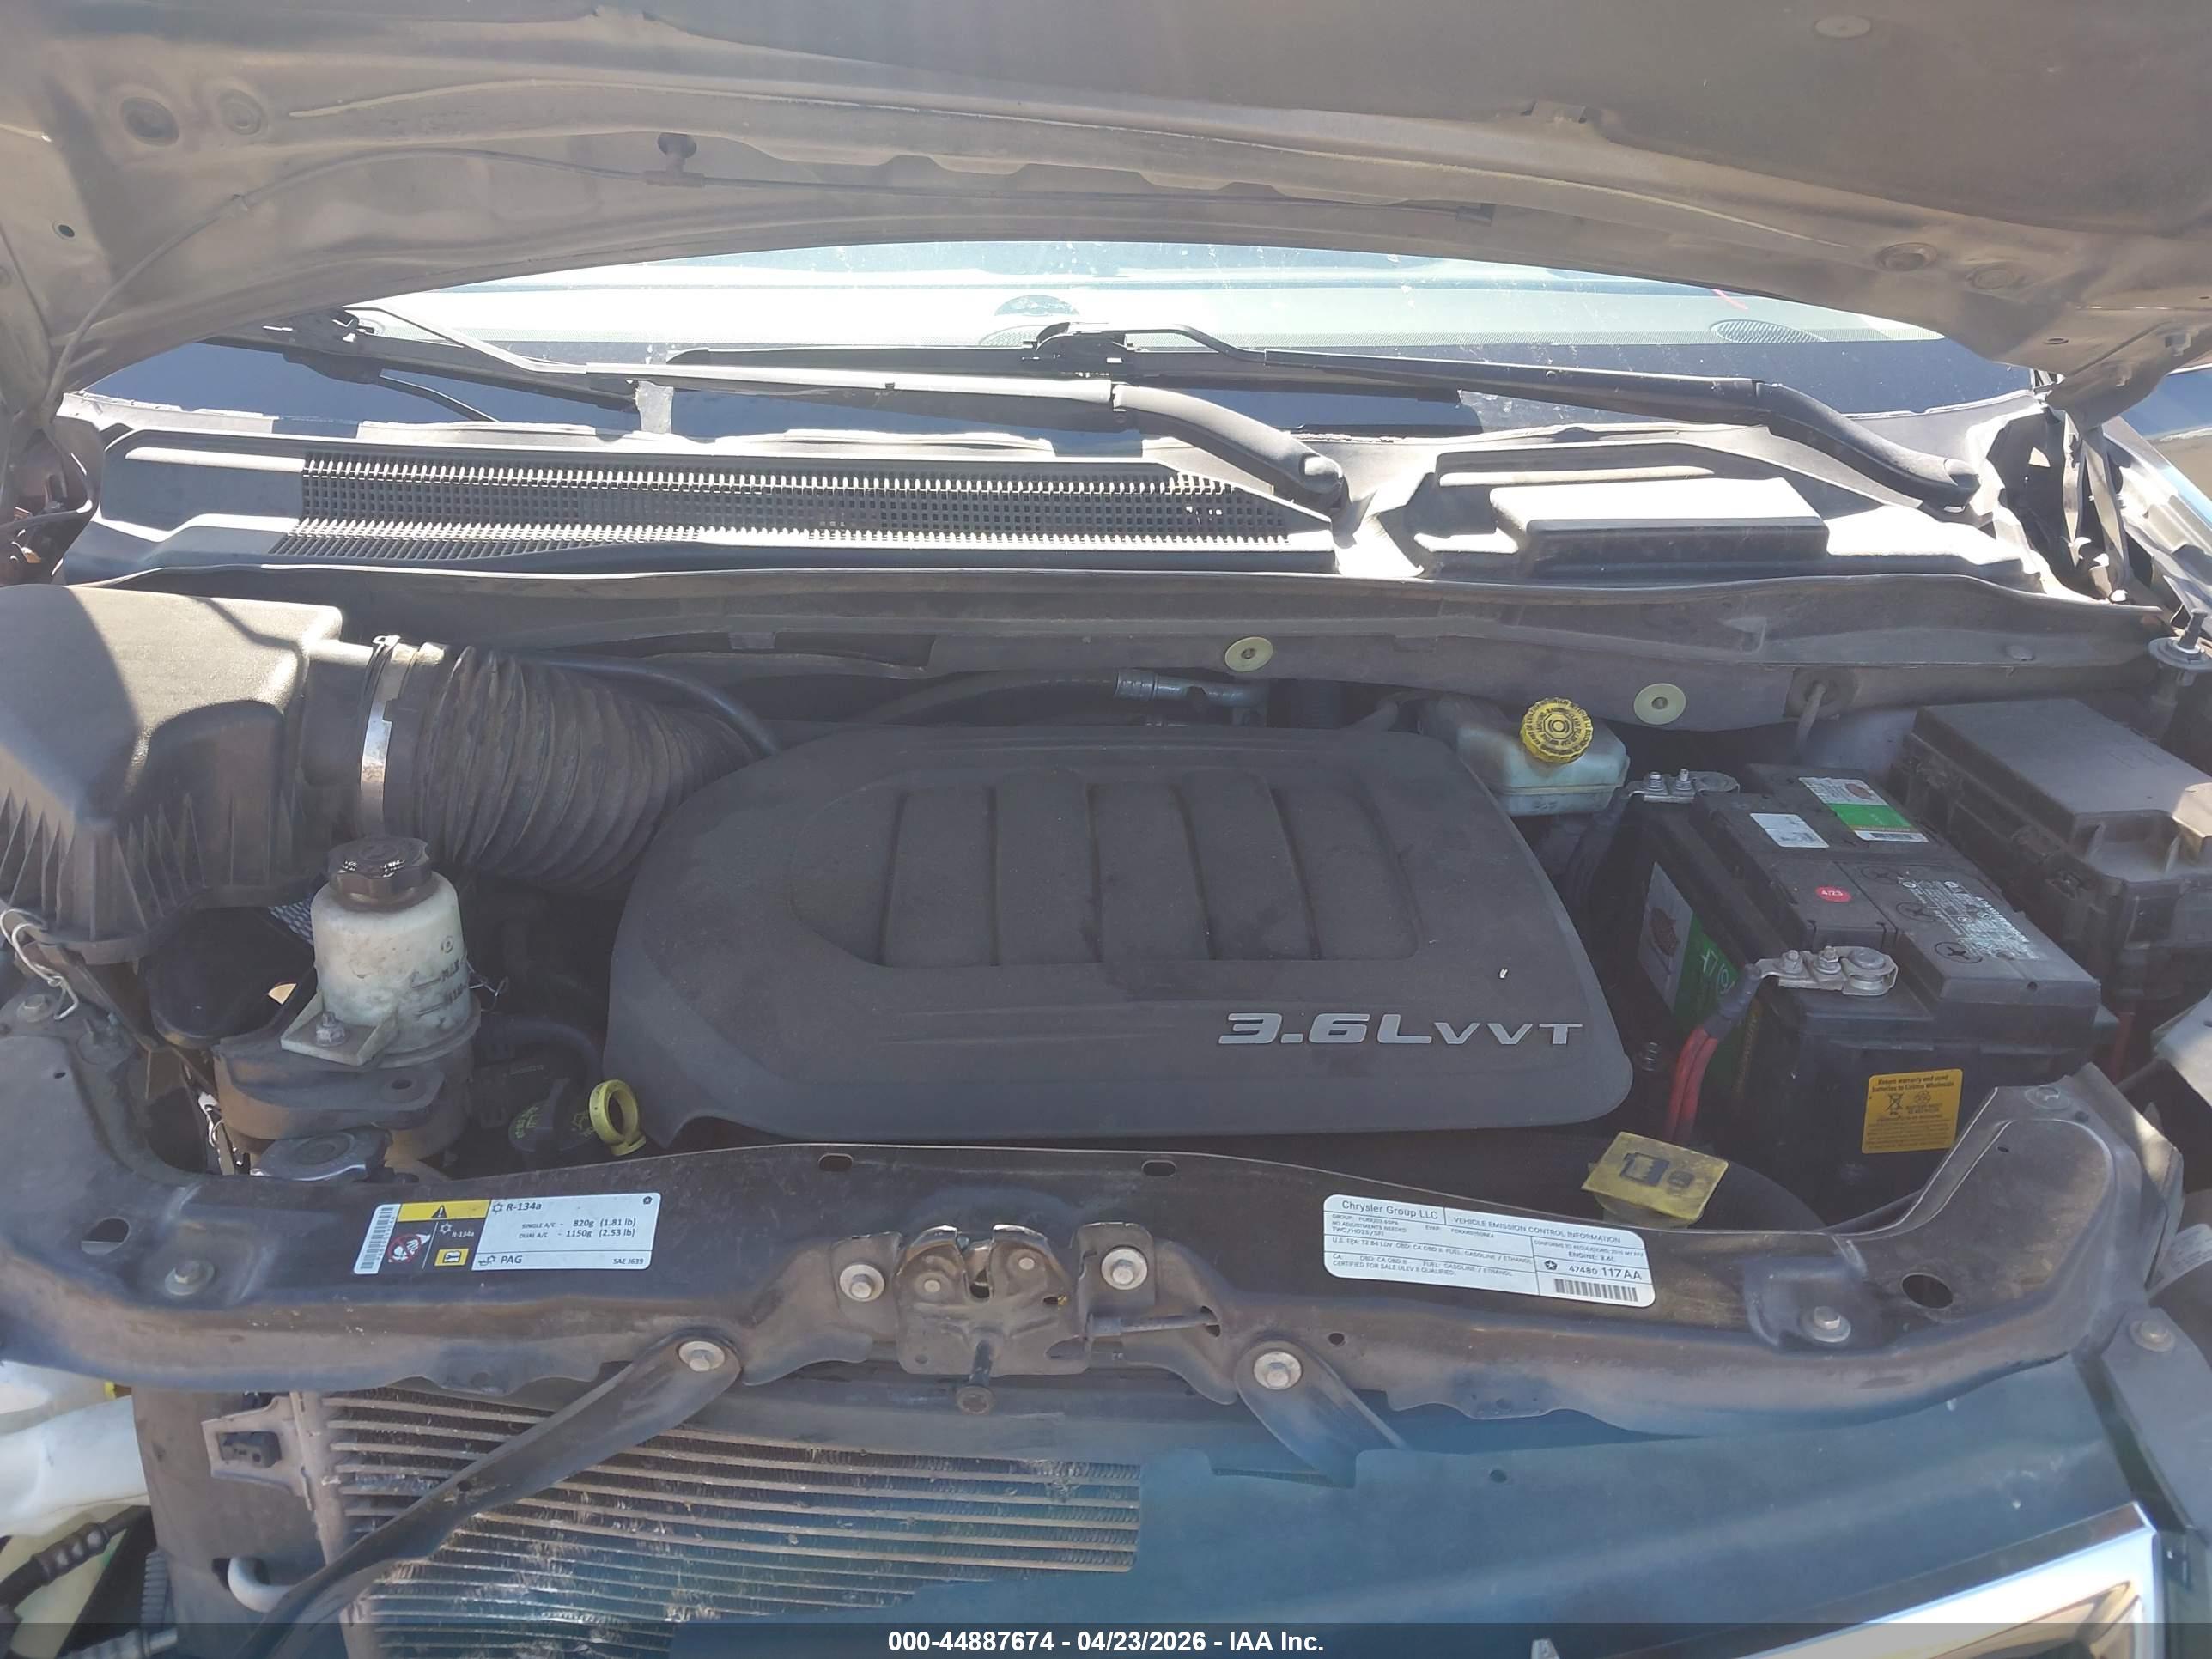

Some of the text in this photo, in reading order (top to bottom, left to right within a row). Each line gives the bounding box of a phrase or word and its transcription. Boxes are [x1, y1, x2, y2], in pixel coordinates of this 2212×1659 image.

[1218, 1012, 1584, 1046] 3.6L VVT
[506, 1202, 543, 1212] R-134a
[1342, 1200, 1438, 1220] Chrysler Group LLC
[573, 1219, 594, 1229] 820g
[599, 1218, 622, 1227] (1.81
[624, 1218, 637, 1227] lb)
[566, 1229, 592, 1238] 1150g
[599, 1229, 621, 1237] (2.53
[623, 1228, 635, 1237] lb)
[1453, 1216, 1621, 1244] VEHICLE EMISSION CONTROL INFORMATION
[500, 1255, 523, 1265] PAG
[1332, 1260, 1364, 1269] CERTIFIED
[1568, 1265, 1598, 1275] 47480
